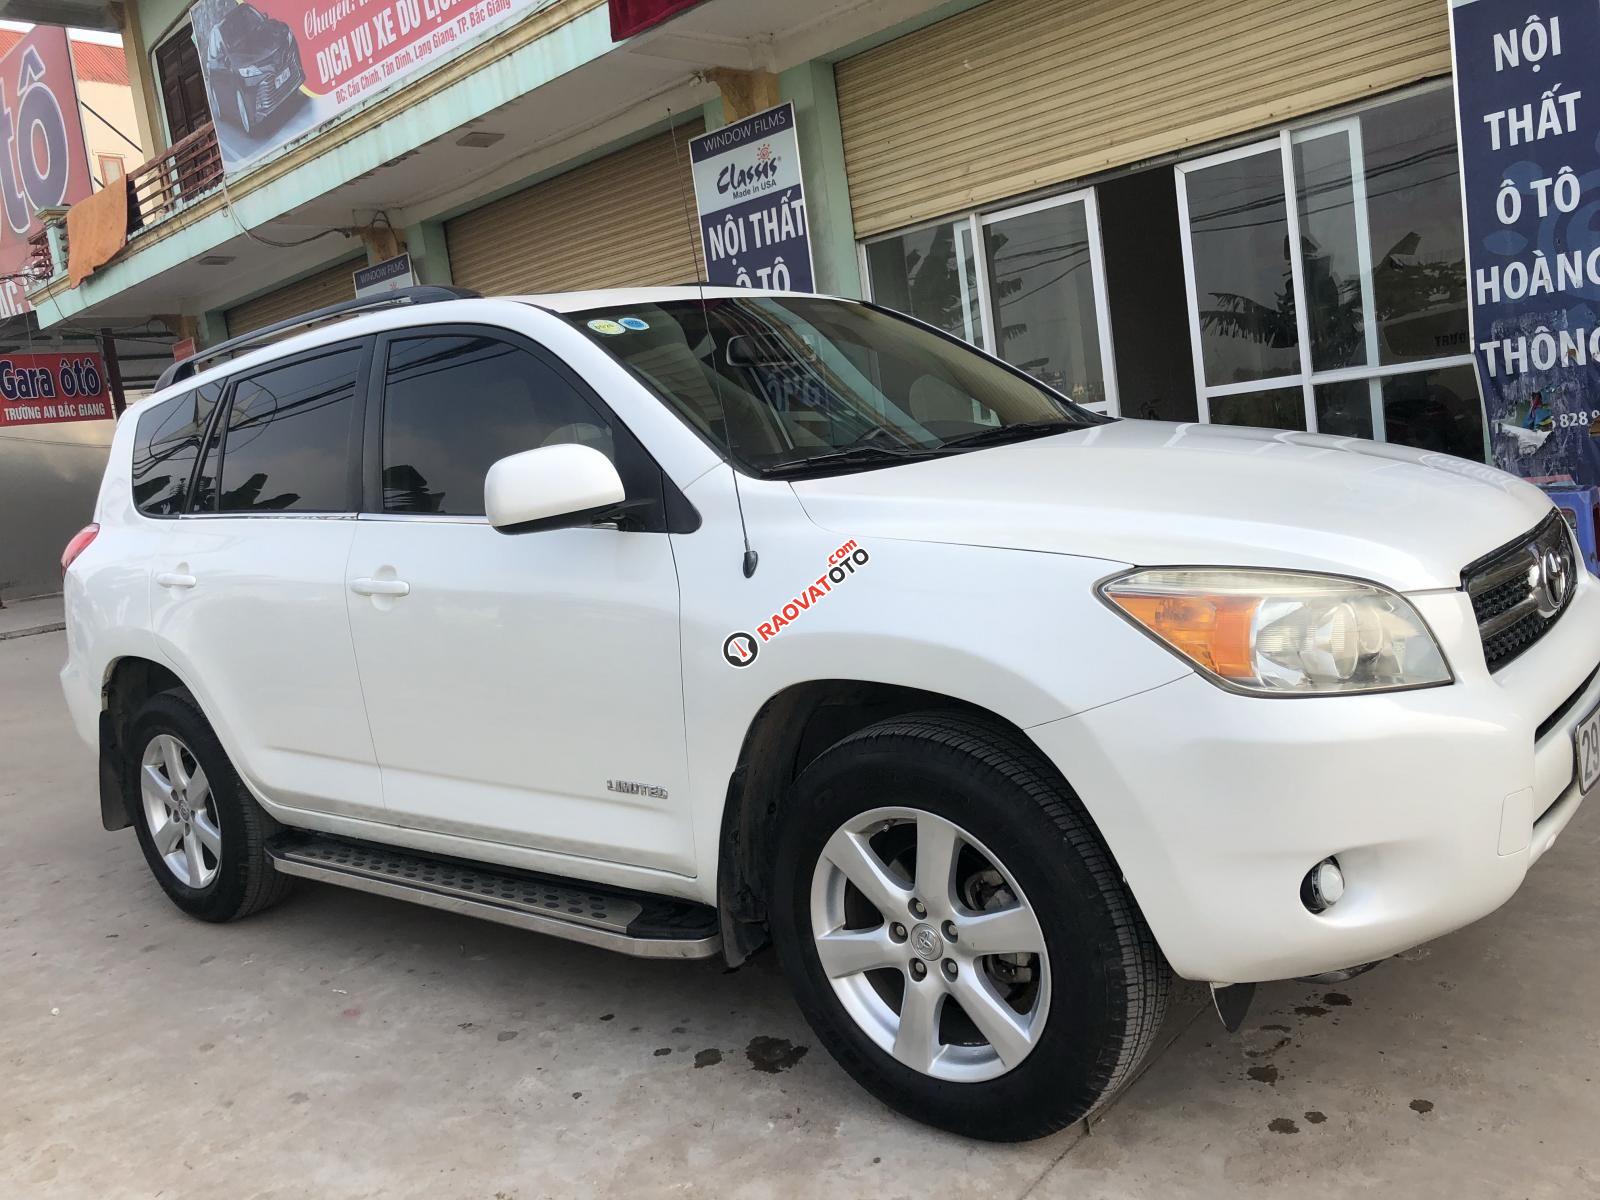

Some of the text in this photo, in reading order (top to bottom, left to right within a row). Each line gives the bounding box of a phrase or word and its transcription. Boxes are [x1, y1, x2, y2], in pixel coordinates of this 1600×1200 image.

[316, 35, 353, 87] DỊCH
[350, 22, 374, 64] VỤ
[372, 7, 397, 50] XE
[432, 27, 458, 49] Giang,
[457, 17, 470, 35] TP.
[1493, 14, 1561, 73] NỘI
[703, 111, 786, 152] WINDOW FILMS
[1483, 82, 1582, 150] THẤT
[732, 189, 752, 200] Made
[761, 179, 777, 191] USA
[1496, 165, 1581, 225] Ô TÔ
[708, 190, 805, 266] NỘI THẤT
[0, 357, 101, 400] Gara ôtô
[43, 405, 57, 419] AN
[78, 402, 106, 417] GIANG
[1559, 410, 1589, 428] 828
[1581, 714, 1600, 782] 29
[606, 779, 669, 800] LIMITED
